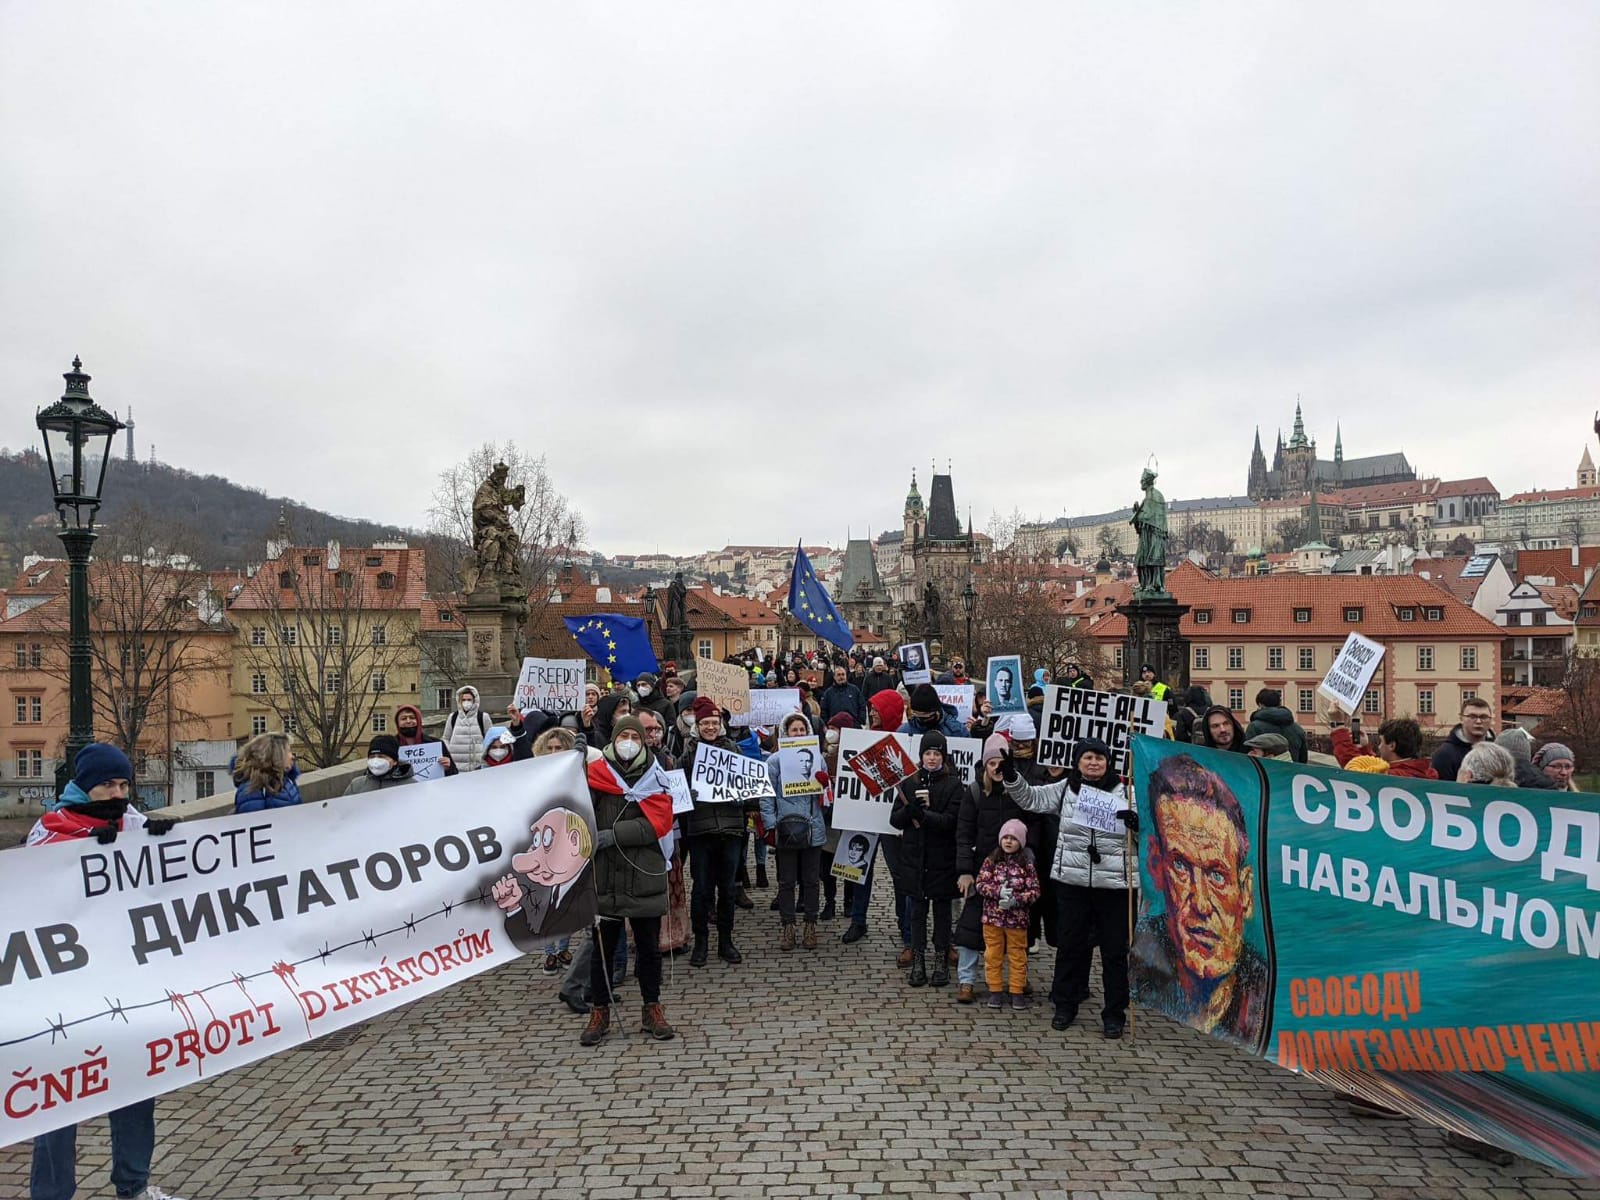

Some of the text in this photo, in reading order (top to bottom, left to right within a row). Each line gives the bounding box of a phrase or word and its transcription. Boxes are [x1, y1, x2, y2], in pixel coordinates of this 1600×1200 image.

[517, 684, 536, 697] FOR
[527, 665, 586, 685] FREEDOM
[1055, 687, 1154, 726] FREE ALL
[405, 748, 425, 758] ФСБ
[698, 747, 765, 778] JSME LED
[695, 764, 724, 786] POD
[712, 787, 773, 801] MAJORA
[1292, 774, 1600, 892] СВОБОД
[80, 823, 275, 898] ВМЕСТЕ
[127, 826, 503, 966] ДИКТАТОРОВ
[1281, 844, 1600, 959] НАВАЛЬНОМ
[1289, 970, 1422, 1022] СВОБОДУ
[4, 928, 494, 1119] ČNĚ PROTI DIKTÁTORŮM
